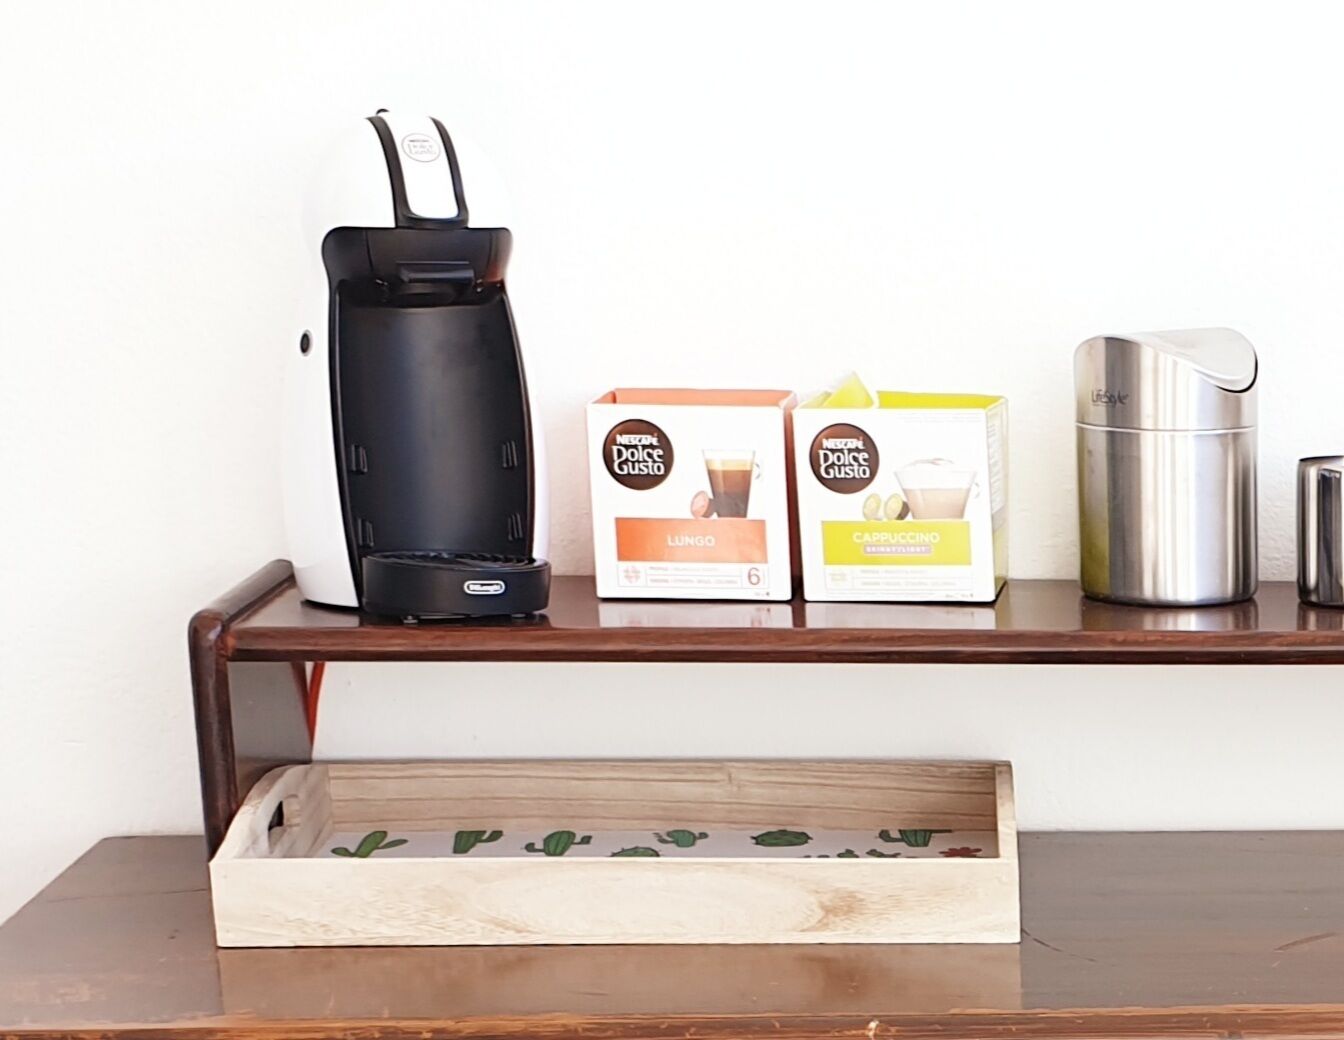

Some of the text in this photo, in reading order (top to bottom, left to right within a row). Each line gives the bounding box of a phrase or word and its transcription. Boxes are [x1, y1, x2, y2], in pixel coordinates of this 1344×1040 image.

[611, 445, 664, 462] Dolce
[818, 449, 870, 466] Dolce
[613, 460, 666, 475] Gusto
[820, 464, 871, 479] Gusto
[667, 535, 716, 547] LUNGO
[852, 531, 941, 544] CAPPUCCINO
[747, 567, 761, 586] 6
